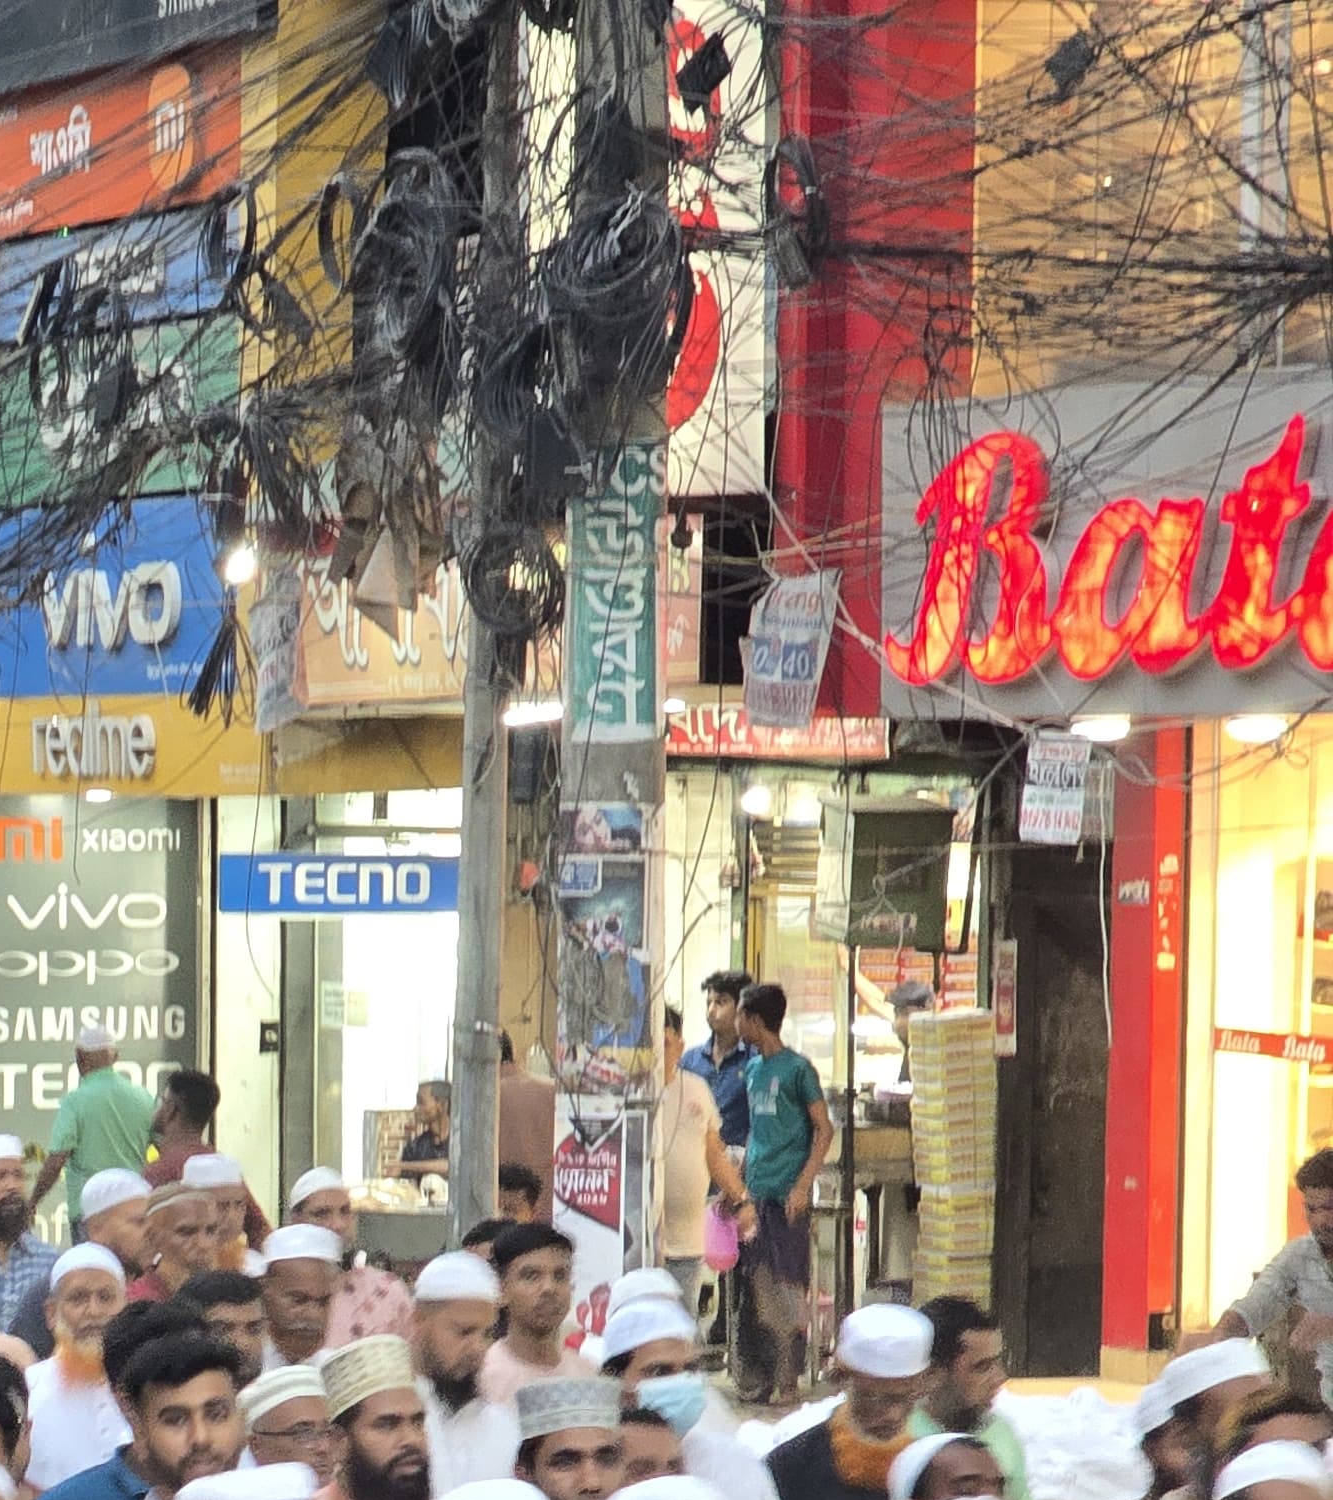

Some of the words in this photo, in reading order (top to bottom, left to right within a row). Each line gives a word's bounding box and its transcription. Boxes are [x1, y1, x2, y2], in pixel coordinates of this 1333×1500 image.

[885, 412, 1333, 686] Bat
[44, 531, 182, 650] vivo
[32, 699, 158, 779] realme
[81, 827, 181, 853] xiaomi
[7, 881, 167, 930] vivo
[258, 861, 431, 905] TECNO
[1220, 1031, 1261, 1053] Bata
[1282, 1036, 1326, 1063] Bata
